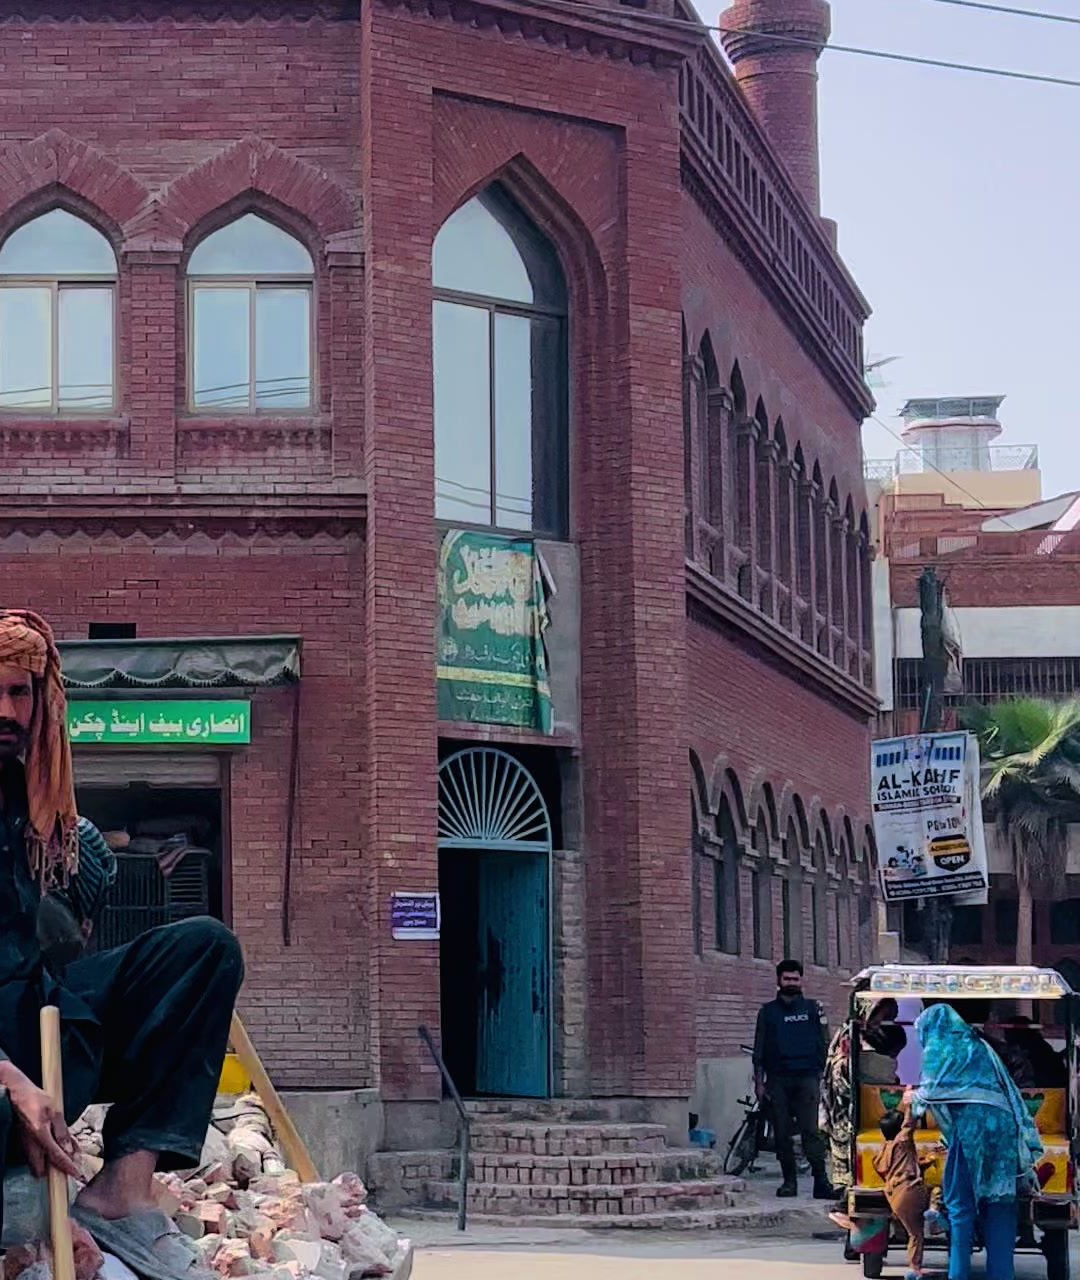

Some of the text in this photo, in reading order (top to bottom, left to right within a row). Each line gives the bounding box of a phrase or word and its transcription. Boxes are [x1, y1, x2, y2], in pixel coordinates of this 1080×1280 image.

[69, 708, 245, 741] انصاری بیف اینڈ چکن
[878, 768, 961, 791] AL-KAHF
[876, 788, 920, 801] ISLAMIC
